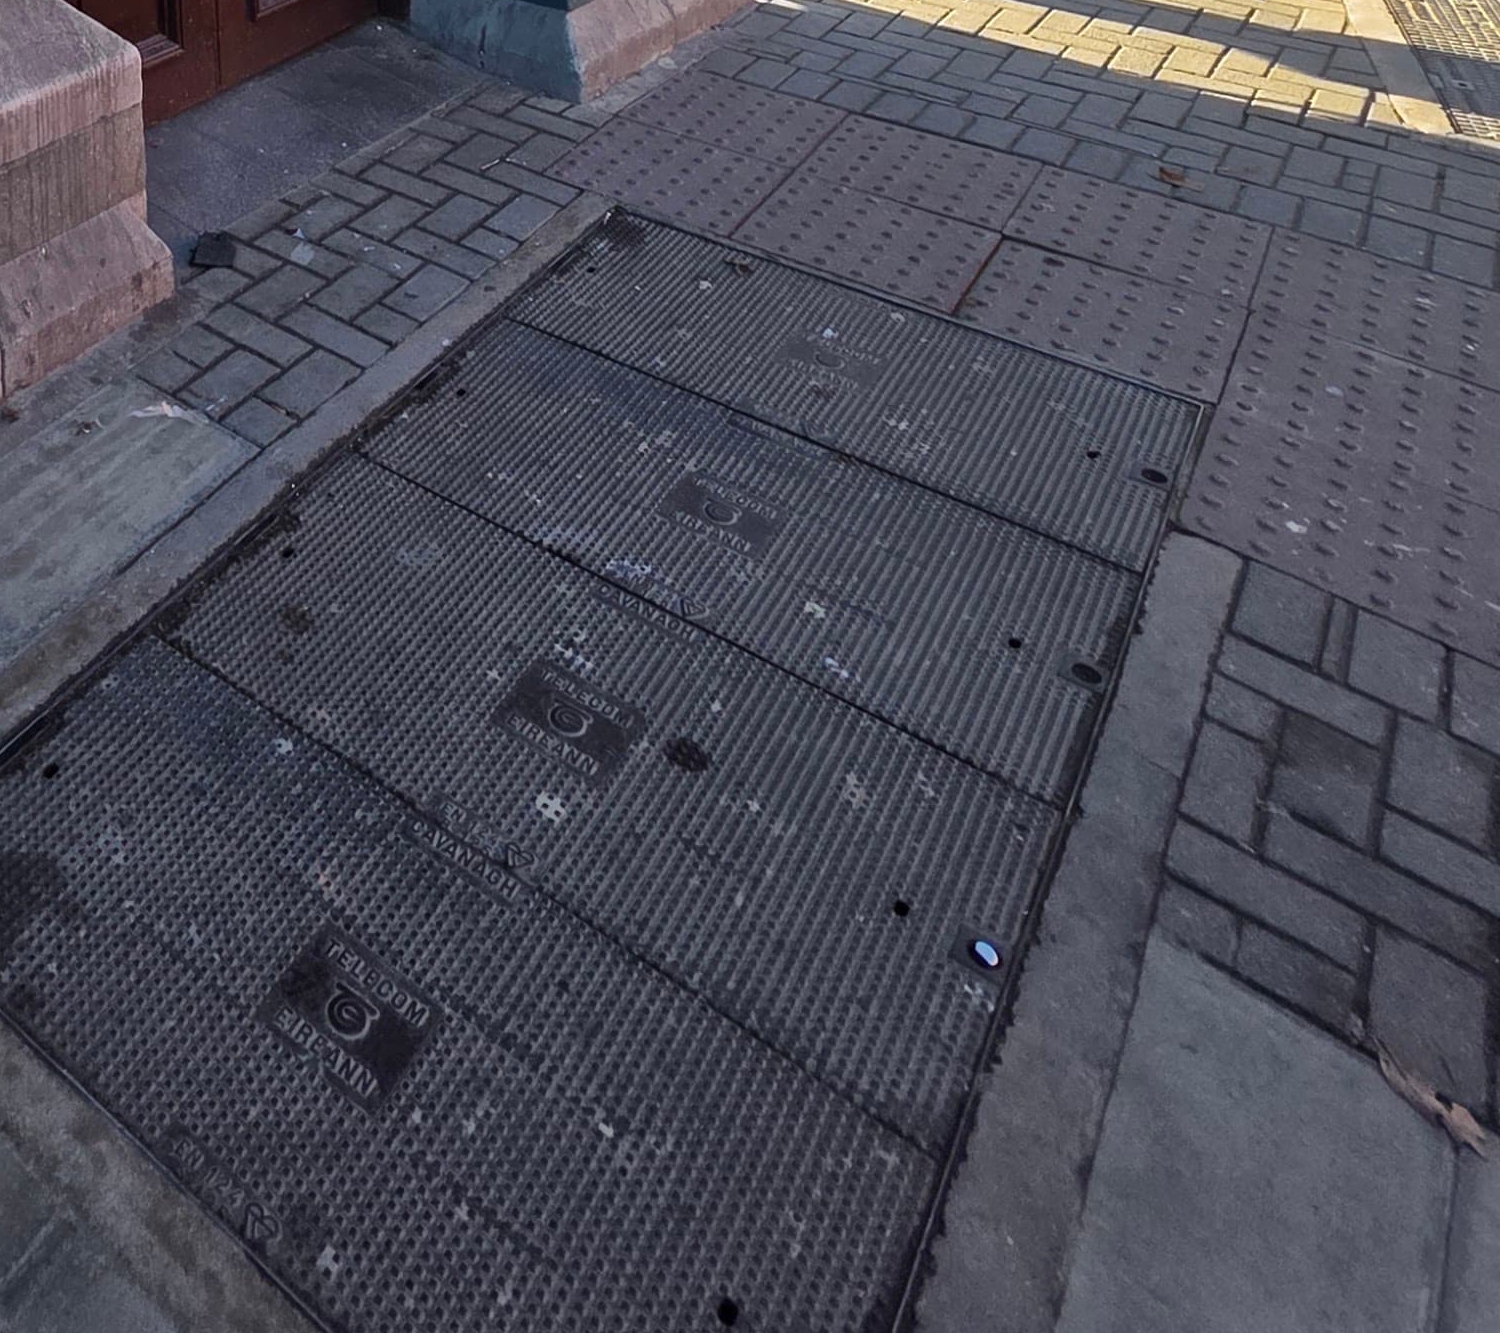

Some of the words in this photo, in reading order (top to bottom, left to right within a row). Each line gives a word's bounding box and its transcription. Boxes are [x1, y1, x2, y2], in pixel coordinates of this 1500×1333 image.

[541, 669, 635, 729] TELECOM
[506, 714, 599, 776] EIREANN
[412, 820, 521, 901] CAVANAGH
[325, 938, 430, 1028] TELECOM
[274, 1005, 379, 1098] EIREANN
